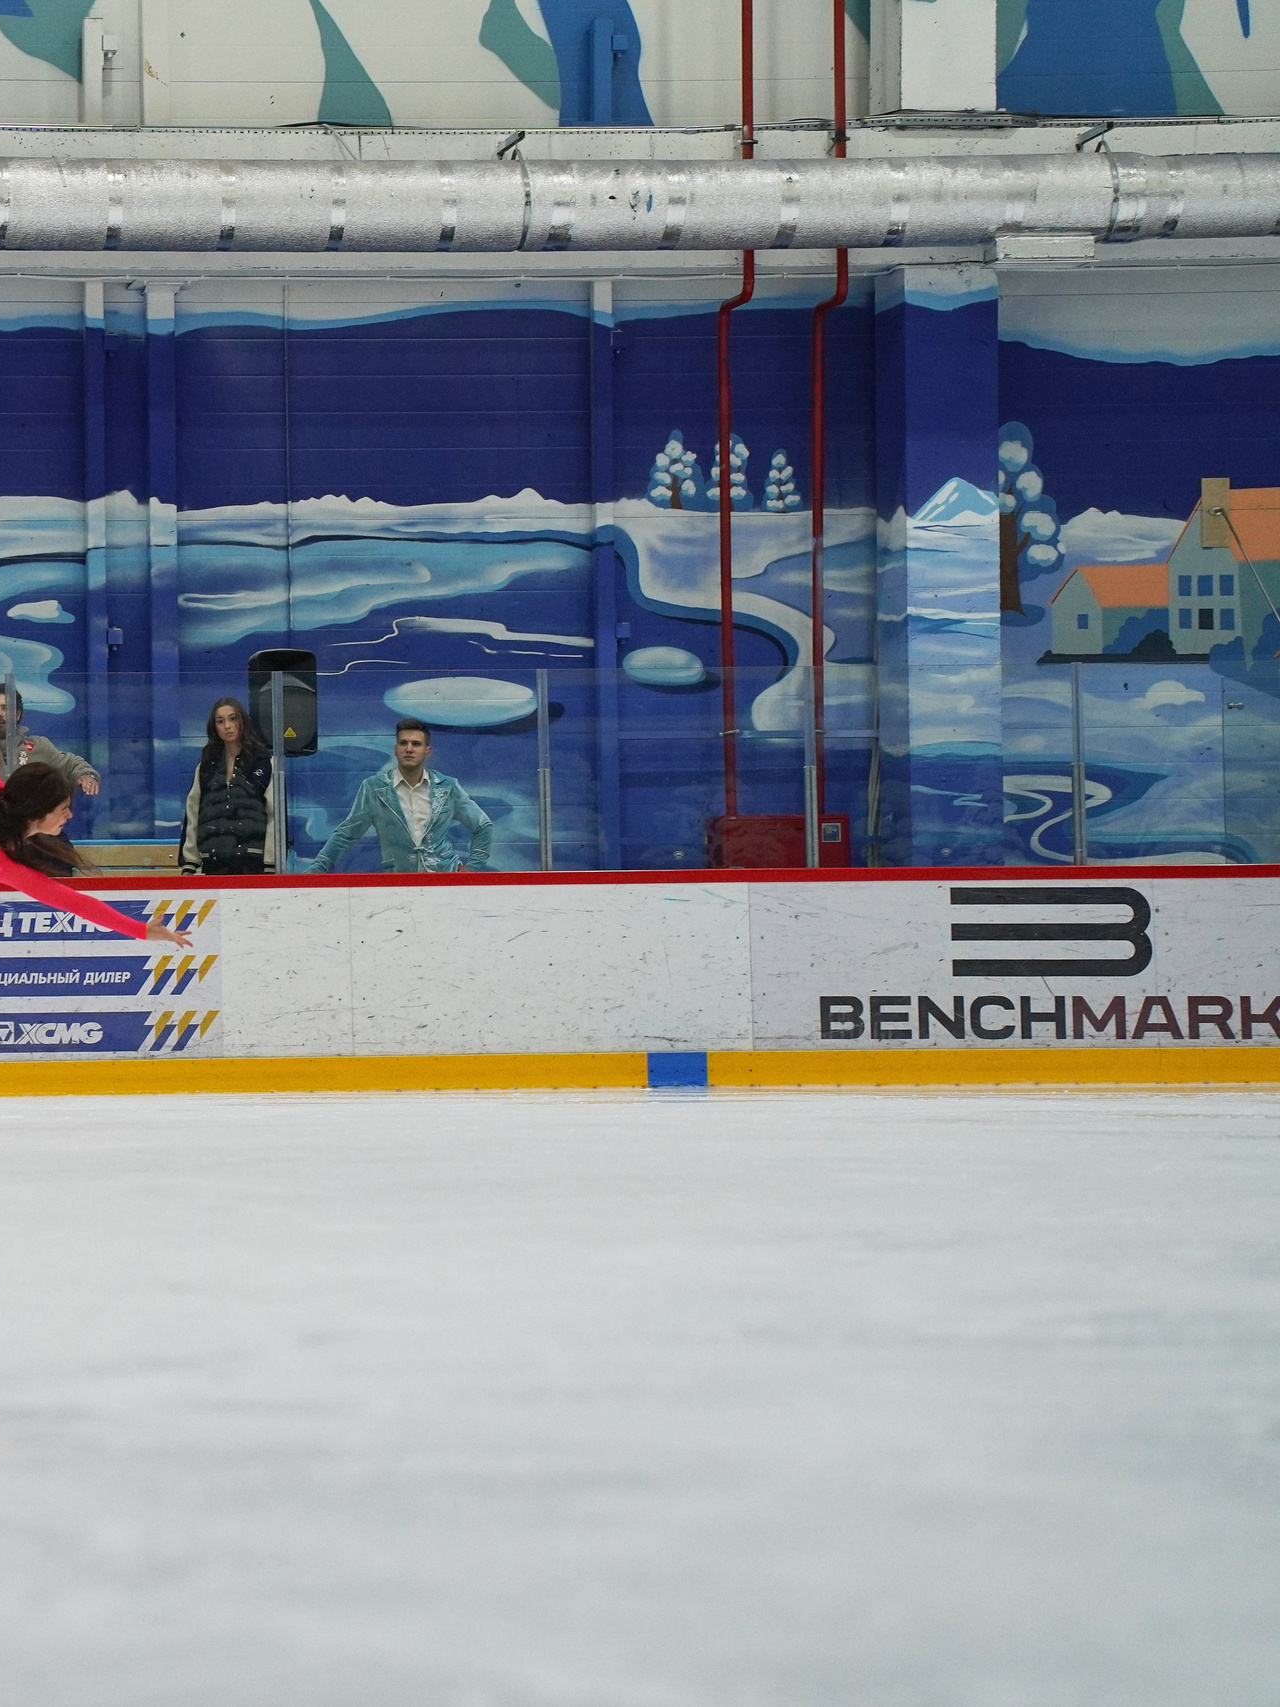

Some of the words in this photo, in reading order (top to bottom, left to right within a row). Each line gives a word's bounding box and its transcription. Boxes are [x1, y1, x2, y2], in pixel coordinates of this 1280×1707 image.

[83, 971, 131, 985] ДИЛЕР
[820, 995, 1280, 1040] BENCHMARK
[14, 1021, 104, 1045] XCMG
